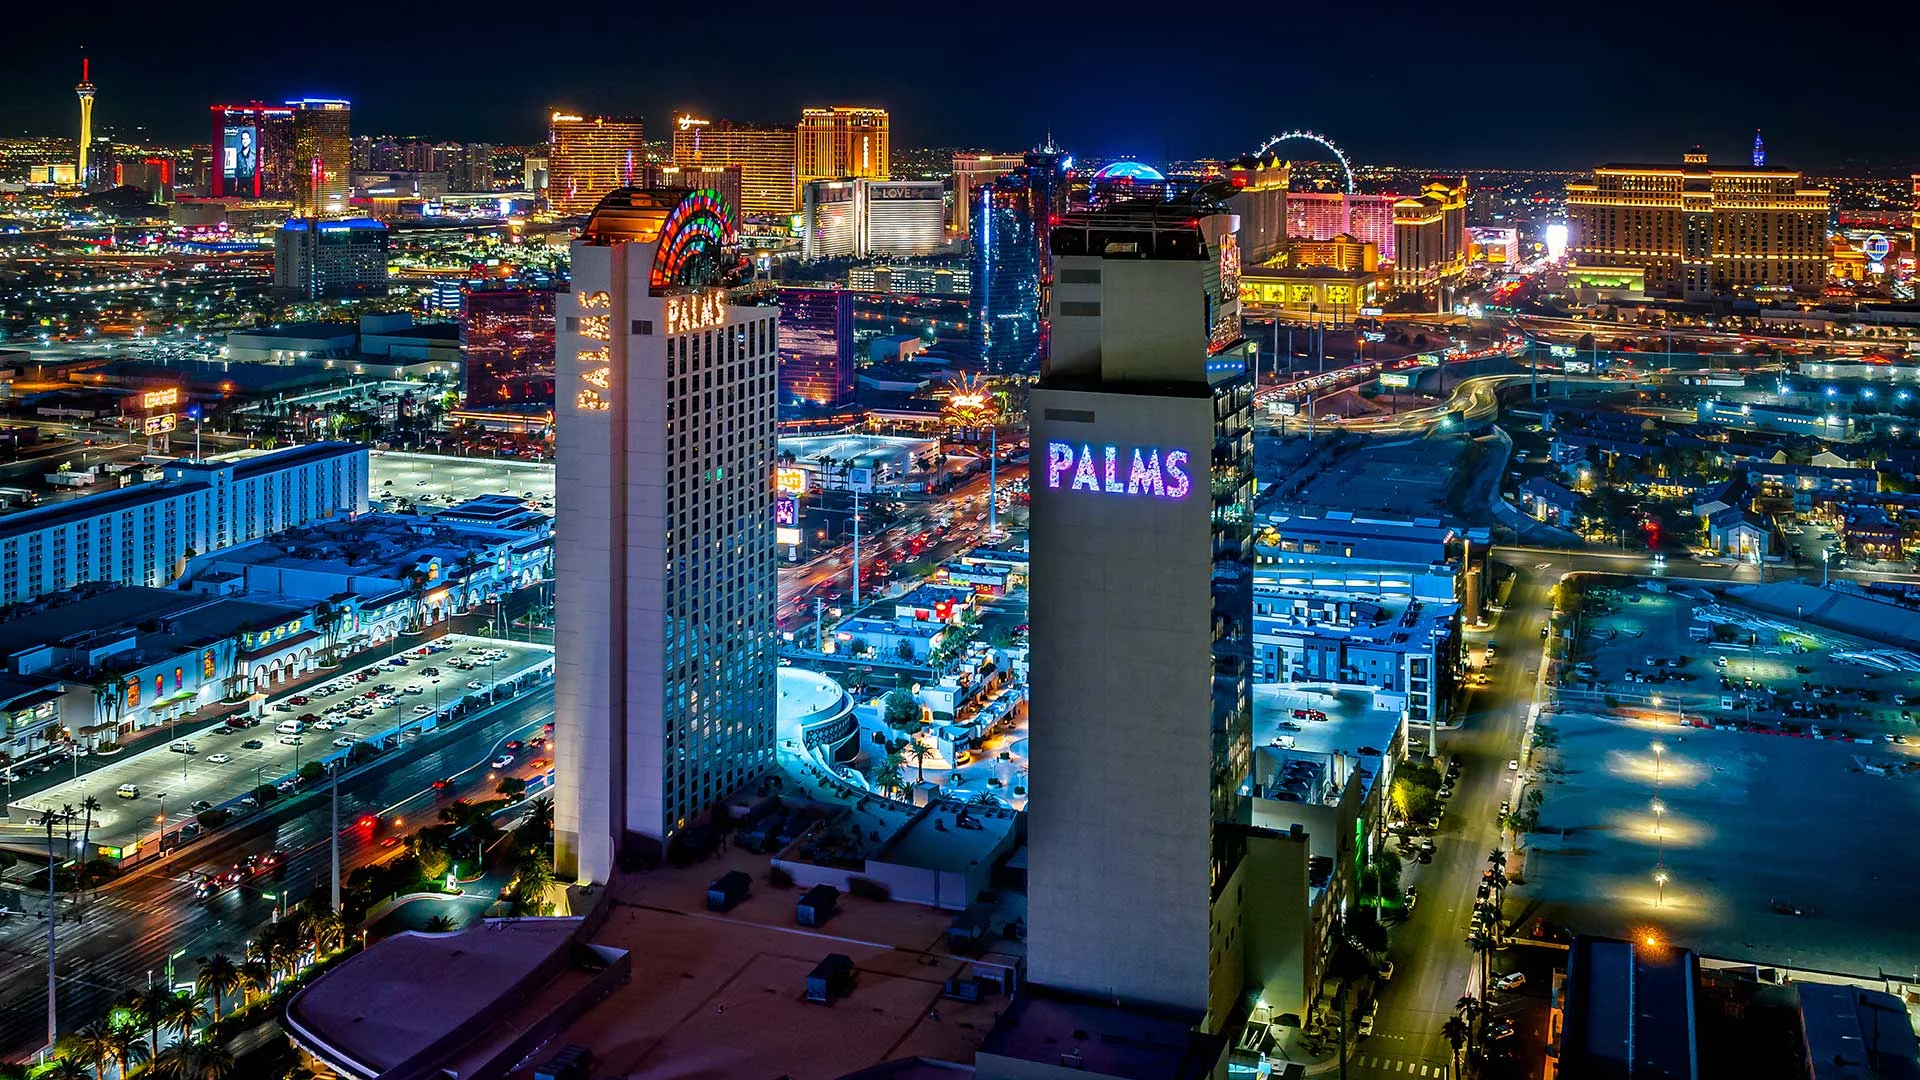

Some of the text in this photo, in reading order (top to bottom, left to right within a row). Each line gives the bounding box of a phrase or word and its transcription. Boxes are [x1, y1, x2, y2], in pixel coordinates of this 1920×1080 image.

[882, 188, 912, 199] LOVE
[667, 290, 726, 335] PALMS
[578, 290, 611, 411] PALMS
[1049, 442, 1190, 498] PALMS
